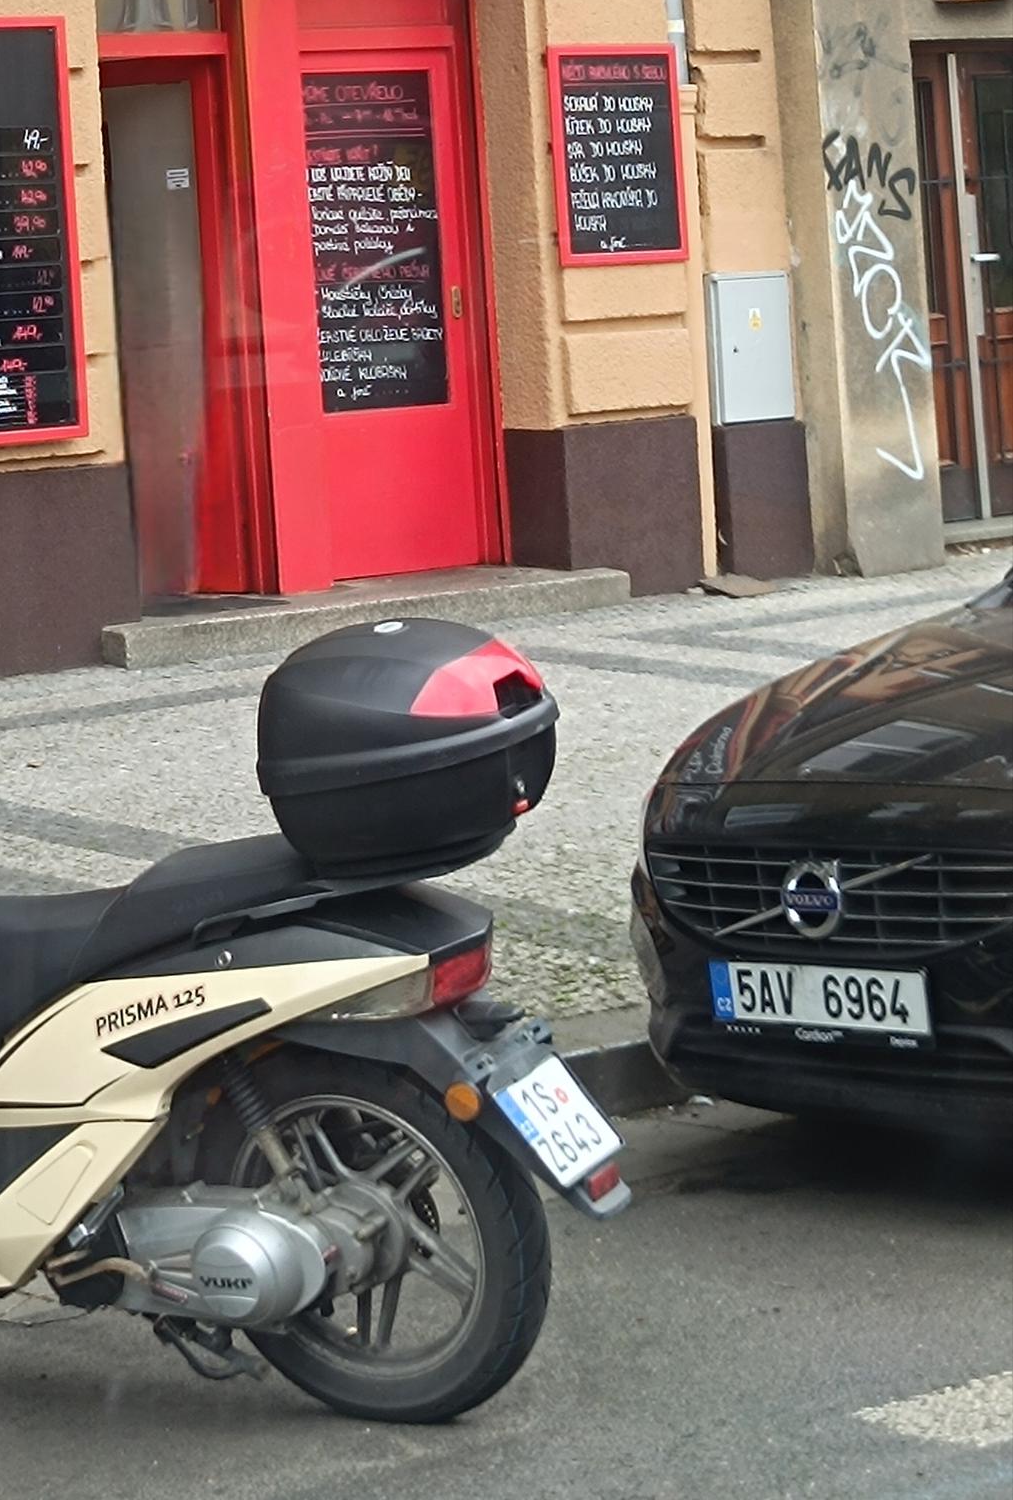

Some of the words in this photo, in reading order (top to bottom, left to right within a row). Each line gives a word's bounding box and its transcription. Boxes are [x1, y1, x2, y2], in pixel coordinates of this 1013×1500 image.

[784, 892, 833, 908] VOLVO
[95, 993, 170, 1038] PRISMA
[172, 984, 207, 1012] 125
[736, 968, 794, 1015] 5AV
[822, 974, 910, 1025] 6964
[199, 1275, 249, 1289] YUKI
